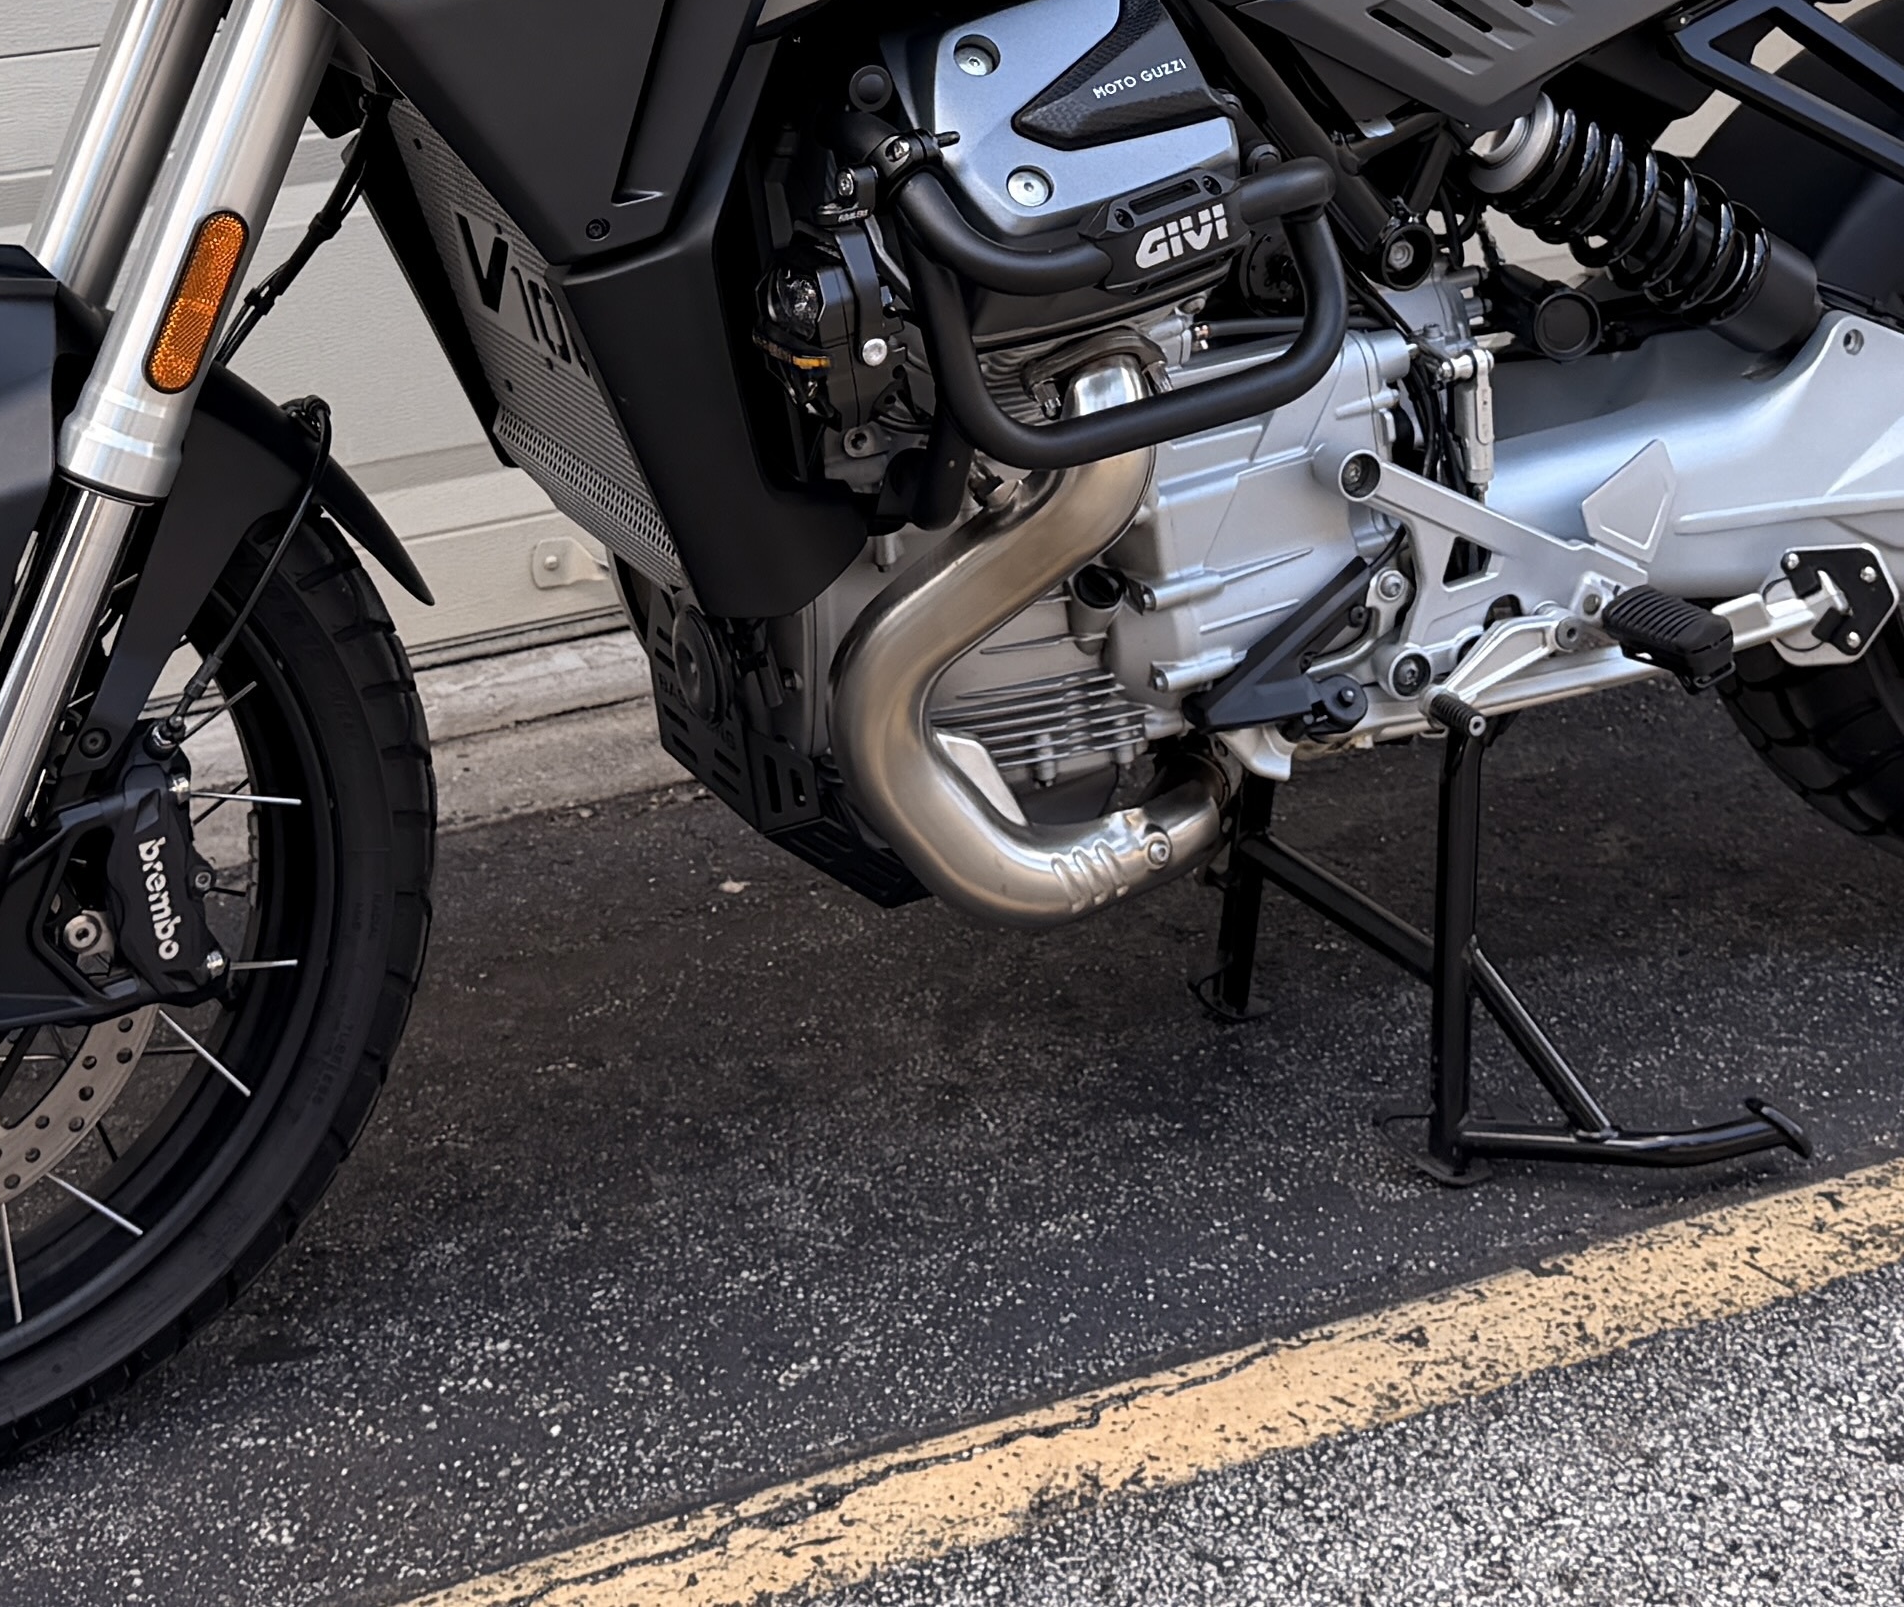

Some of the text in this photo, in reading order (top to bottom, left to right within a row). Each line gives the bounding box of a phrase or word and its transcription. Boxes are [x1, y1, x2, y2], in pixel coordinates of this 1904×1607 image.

[1092, 58, 1187, 99] MOTO GUZZI
[1136, 203, 1229, 269] GIVI
[456, 212, 590, 377] V10
[138, 836, 182, 960] brembo
